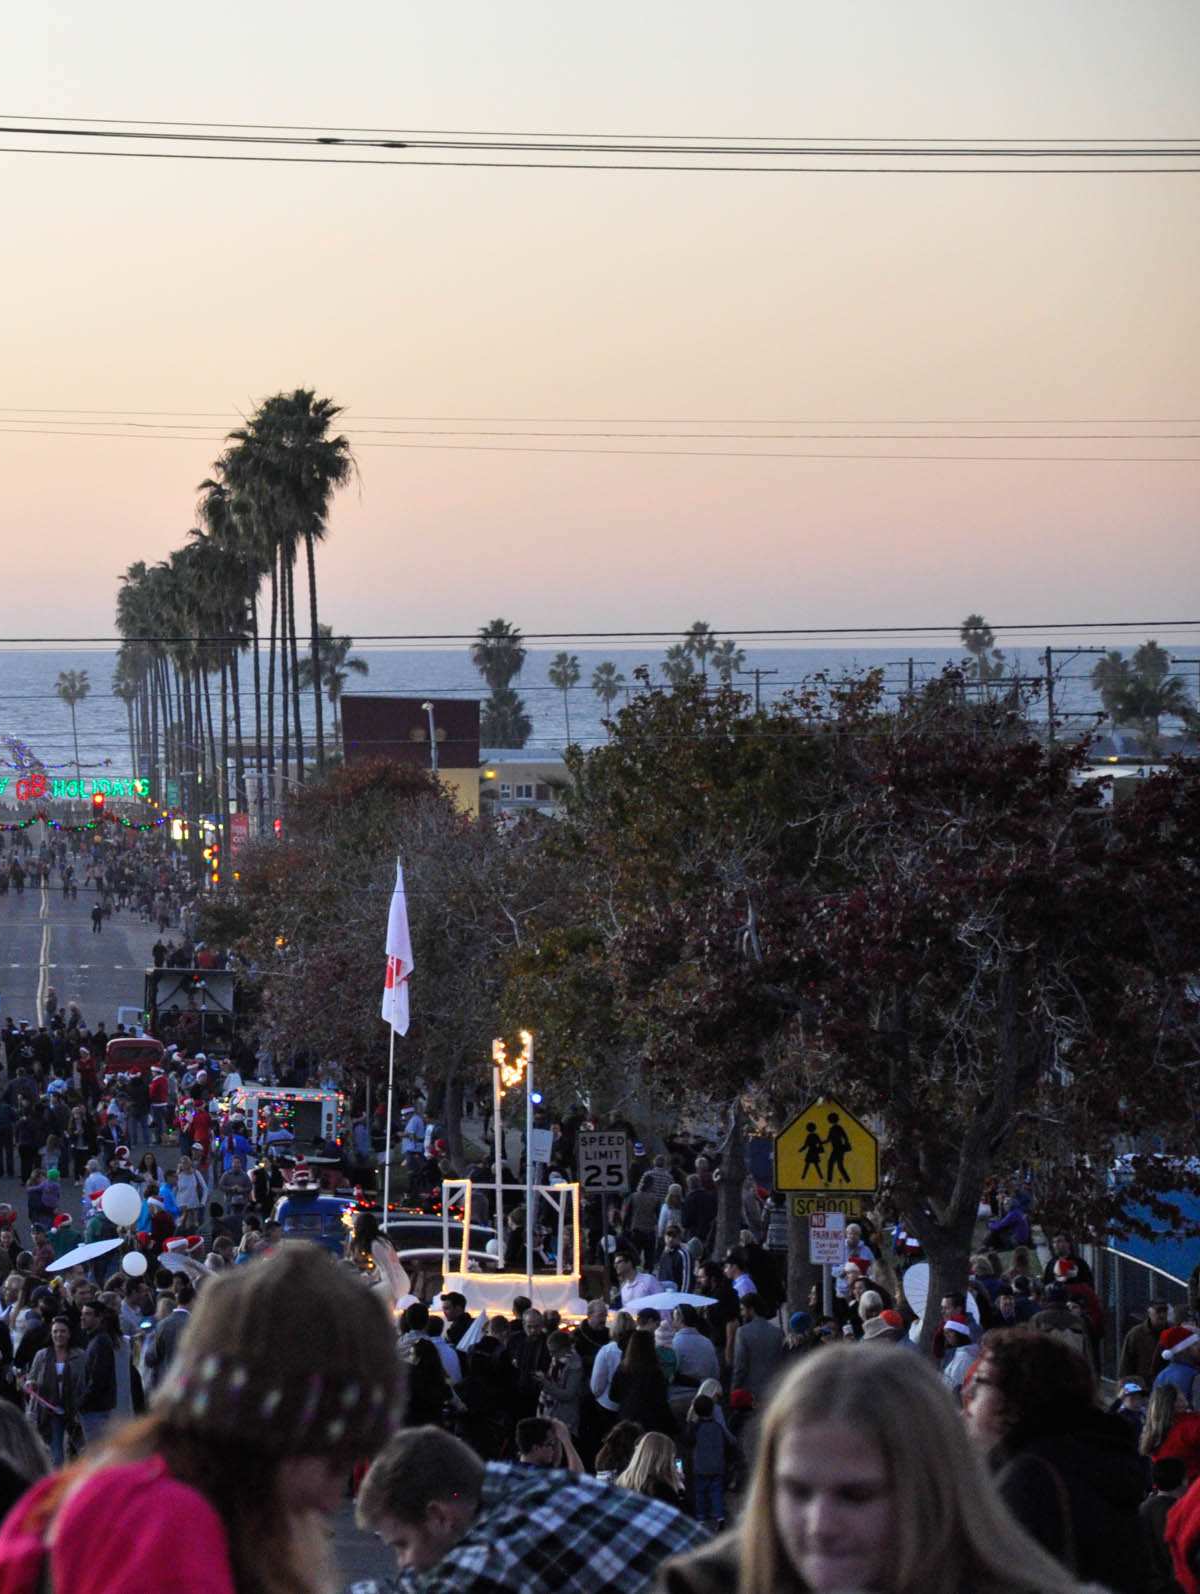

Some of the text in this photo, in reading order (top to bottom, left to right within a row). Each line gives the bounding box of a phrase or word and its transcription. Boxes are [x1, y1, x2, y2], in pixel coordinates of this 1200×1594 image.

[16, 774, 46, 800] OB
[52, 778, 151, 798] HOLIDAYS
[581, 1136, 625, 1146] SPEED
[585, 1151, 621, 1160] LIMIT
[584, 1164, 623, 1186] 25
[797, 1199, 858, 1217] SCHOOL
[812, 1215, 825, 1226] NO
